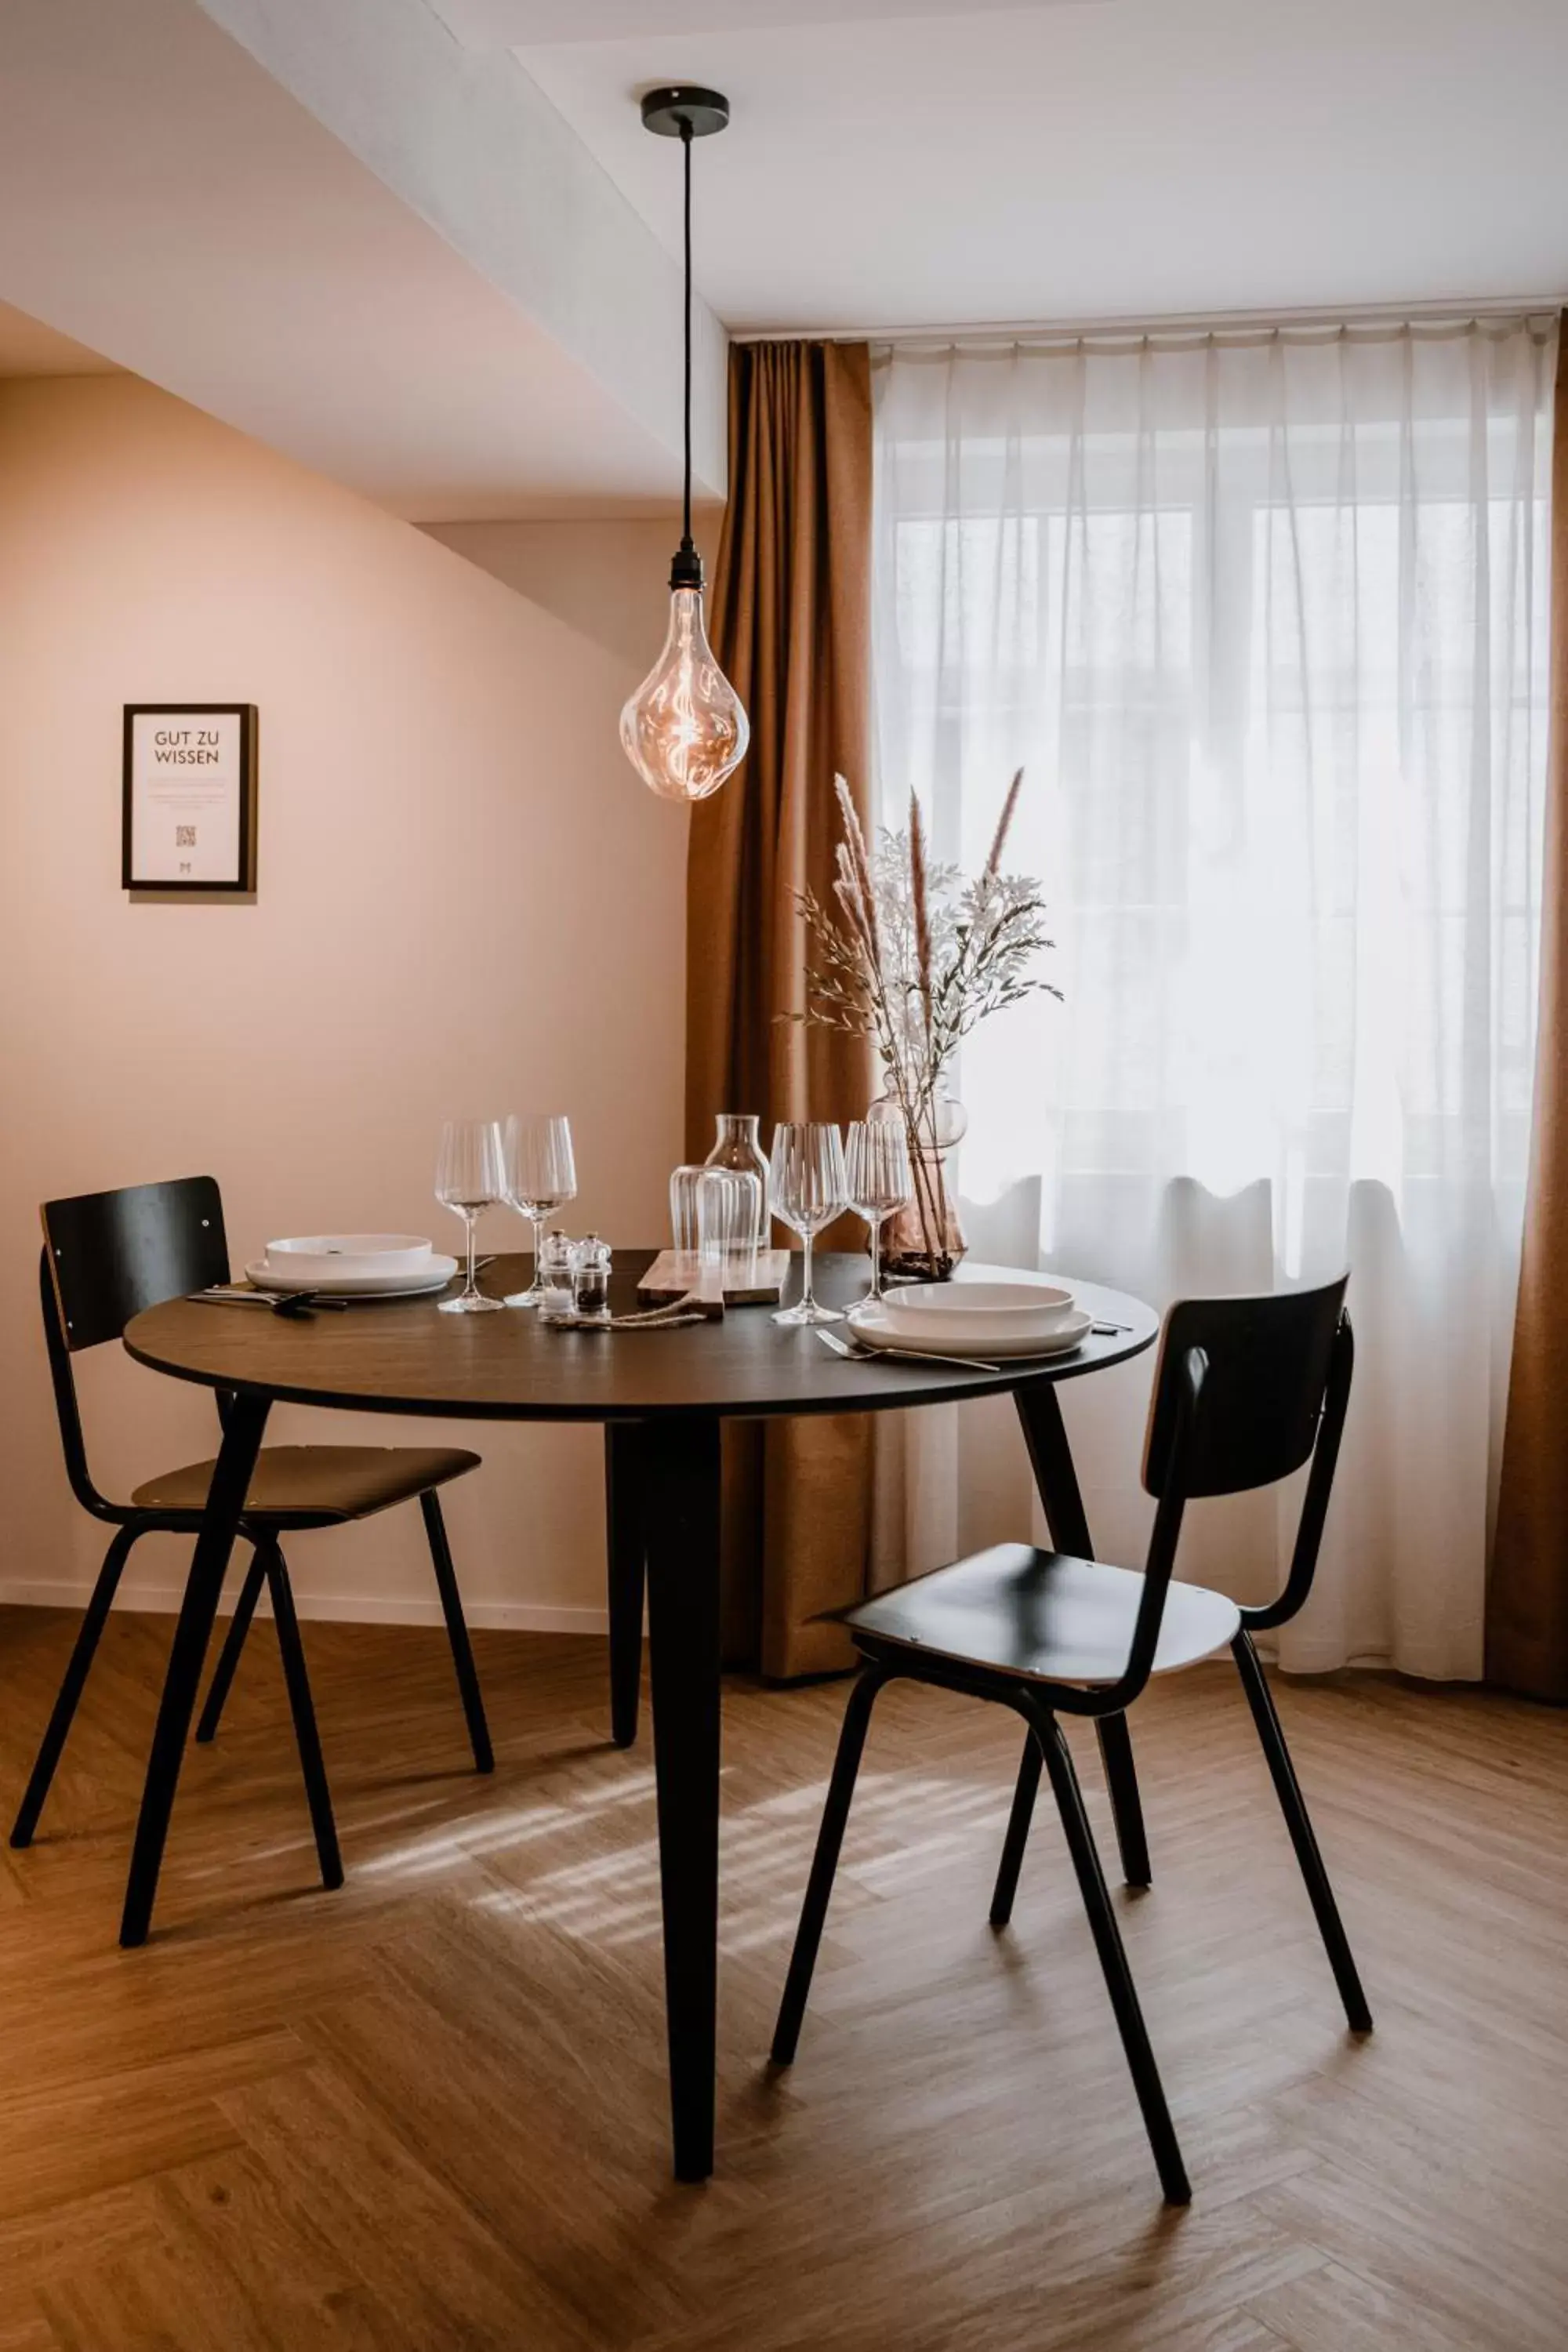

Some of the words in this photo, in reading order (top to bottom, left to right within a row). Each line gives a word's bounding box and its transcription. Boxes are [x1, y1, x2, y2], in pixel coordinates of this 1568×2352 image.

[154, 730, 191, 746] GUT
[197, 730, 219, 746] ZU
[154, 750, 219, 764] WISSEN
